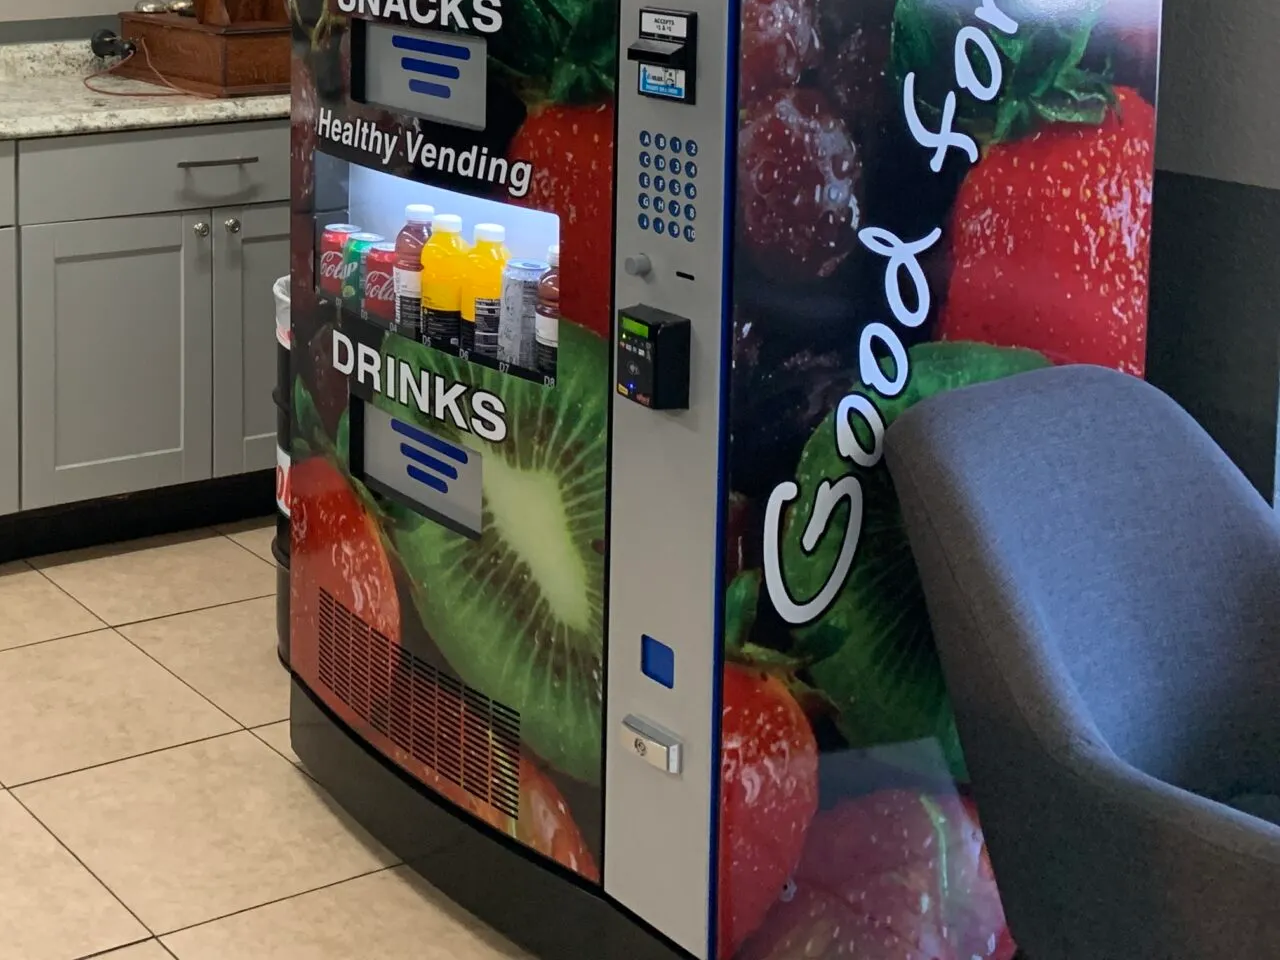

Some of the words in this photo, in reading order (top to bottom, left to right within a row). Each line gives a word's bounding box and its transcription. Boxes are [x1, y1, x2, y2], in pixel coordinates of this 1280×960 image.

[317, 107, 398, 165] Healthy
[406, 131, 533, 198] Vending
[422, 335, 432, 347] D5
[460, 348, 469, 360] D6
[499, 362, 510, 373] D7
[332, 329, 507, 442] DRINKS
[544, 375, 555, 388] D8
[763, 225, 943, 625] Good
